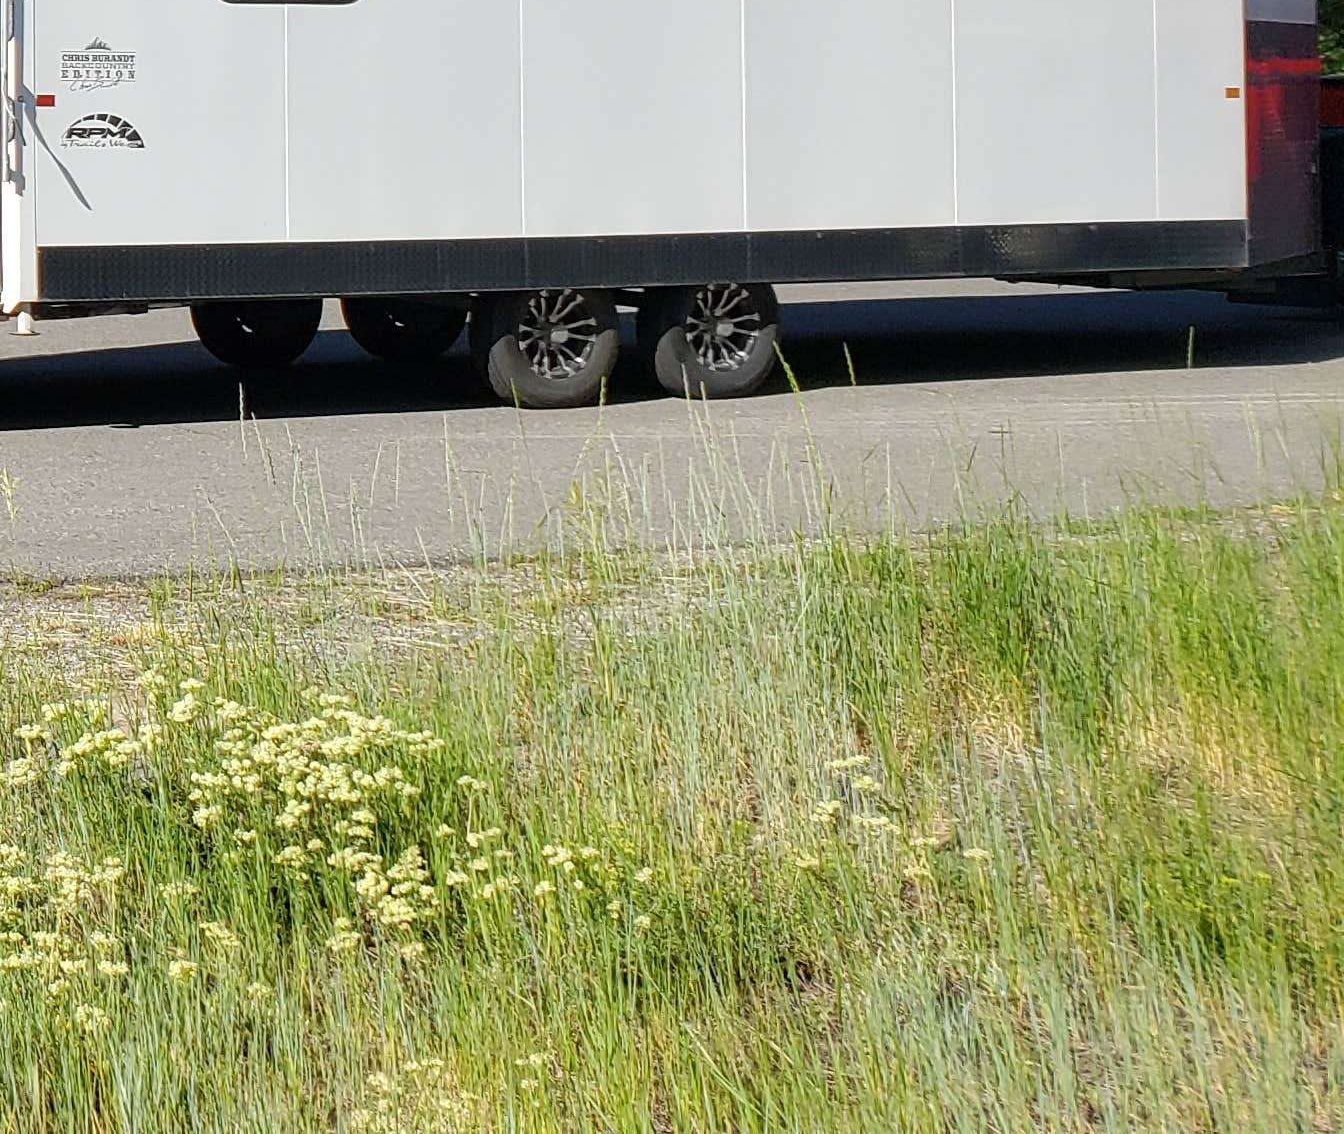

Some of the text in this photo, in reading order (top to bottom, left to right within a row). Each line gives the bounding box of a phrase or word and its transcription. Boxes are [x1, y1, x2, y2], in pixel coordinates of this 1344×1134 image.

[61, 54, 136, 63] CHRIS BURANDT
[61, 62, 136, 70] BACKCOUNTRY
[60, 69, 136, 79] EDITION
[65, 127, 131, 139] RPM
